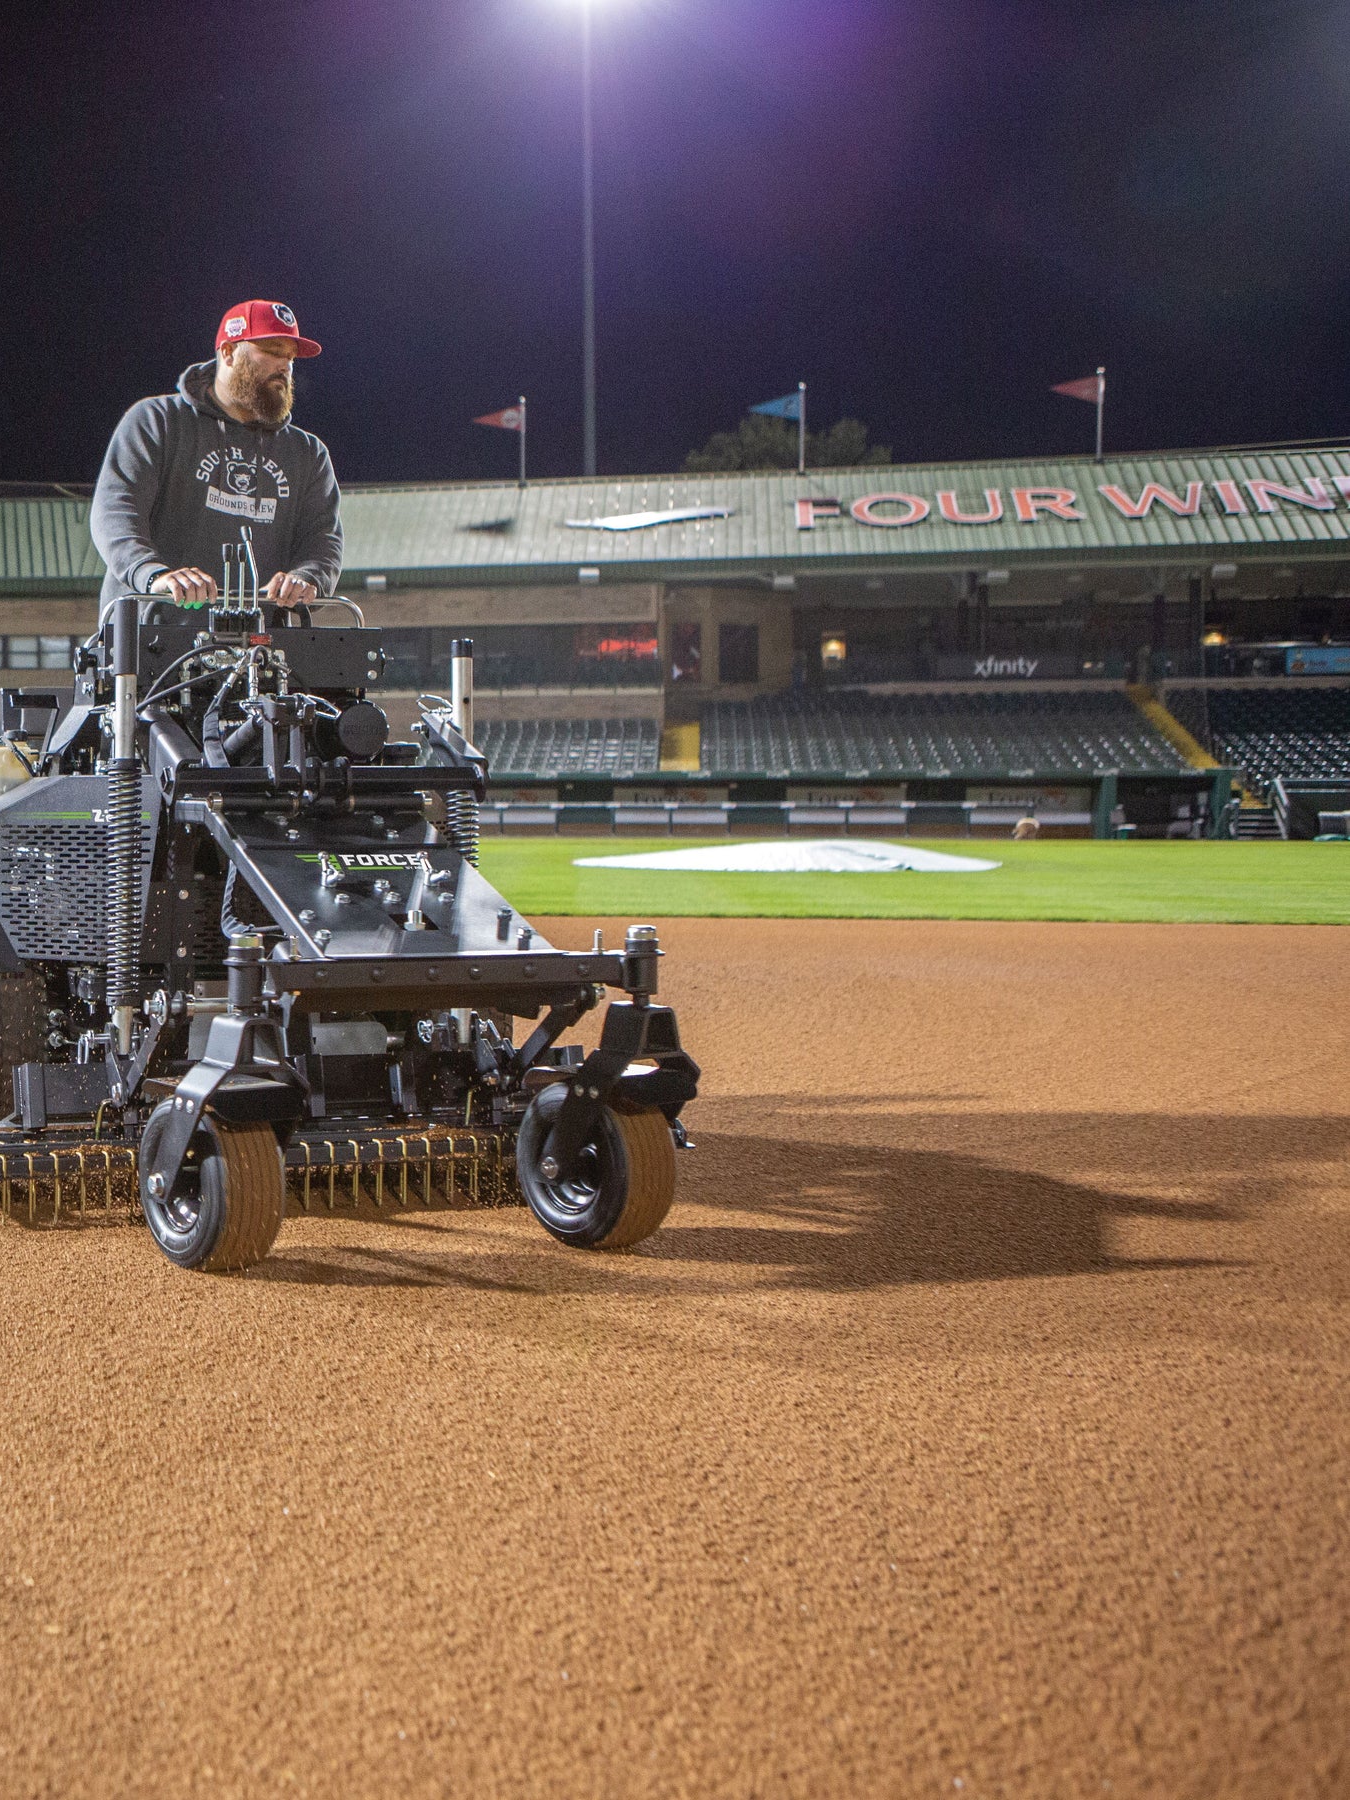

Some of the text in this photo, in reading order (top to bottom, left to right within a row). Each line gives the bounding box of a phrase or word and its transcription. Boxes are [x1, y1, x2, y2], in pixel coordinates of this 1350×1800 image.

[209, 493, 248, 511] GROUNDS
[795, 476, 1350, 530] FOUR WIN
[974, 654, 1038, 678] xfinity
[339, 853, 422, 866] FORCE
